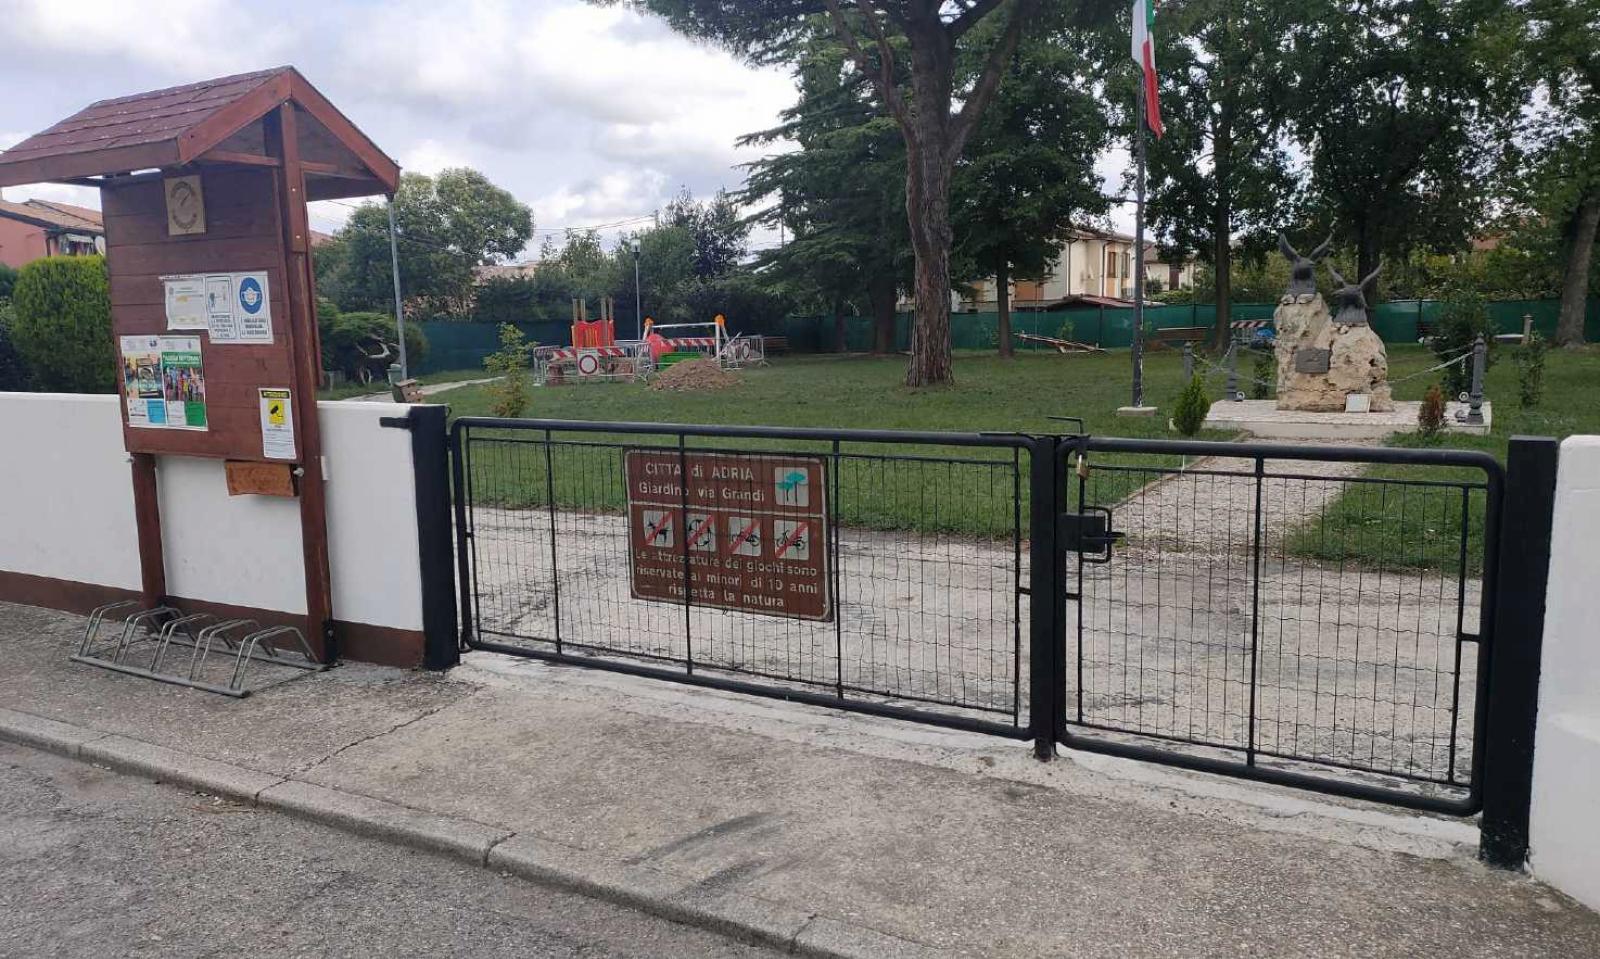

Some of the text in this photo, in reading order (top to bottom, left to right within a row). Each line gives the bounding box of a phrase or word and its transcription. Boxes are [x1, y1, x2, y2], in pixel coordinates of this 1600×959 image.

[691, 464, 703, 478] di
[711, 466, 754, 481] ADRIA
[698, 486, 715, 499] via
[722, 486, 765, 502] Grandi
[724, 554, 743, 570] dei
[747, 558, 784, 576] giochi
[786, 563, 817, 577] sono
[706, 573, 743, 587] minori
[750, 576, 762, 590] di
[768, 578, 784, 592] 10
[789, 582, 818, 595] anni
[668, 583, 784, 608] risetta la natura
